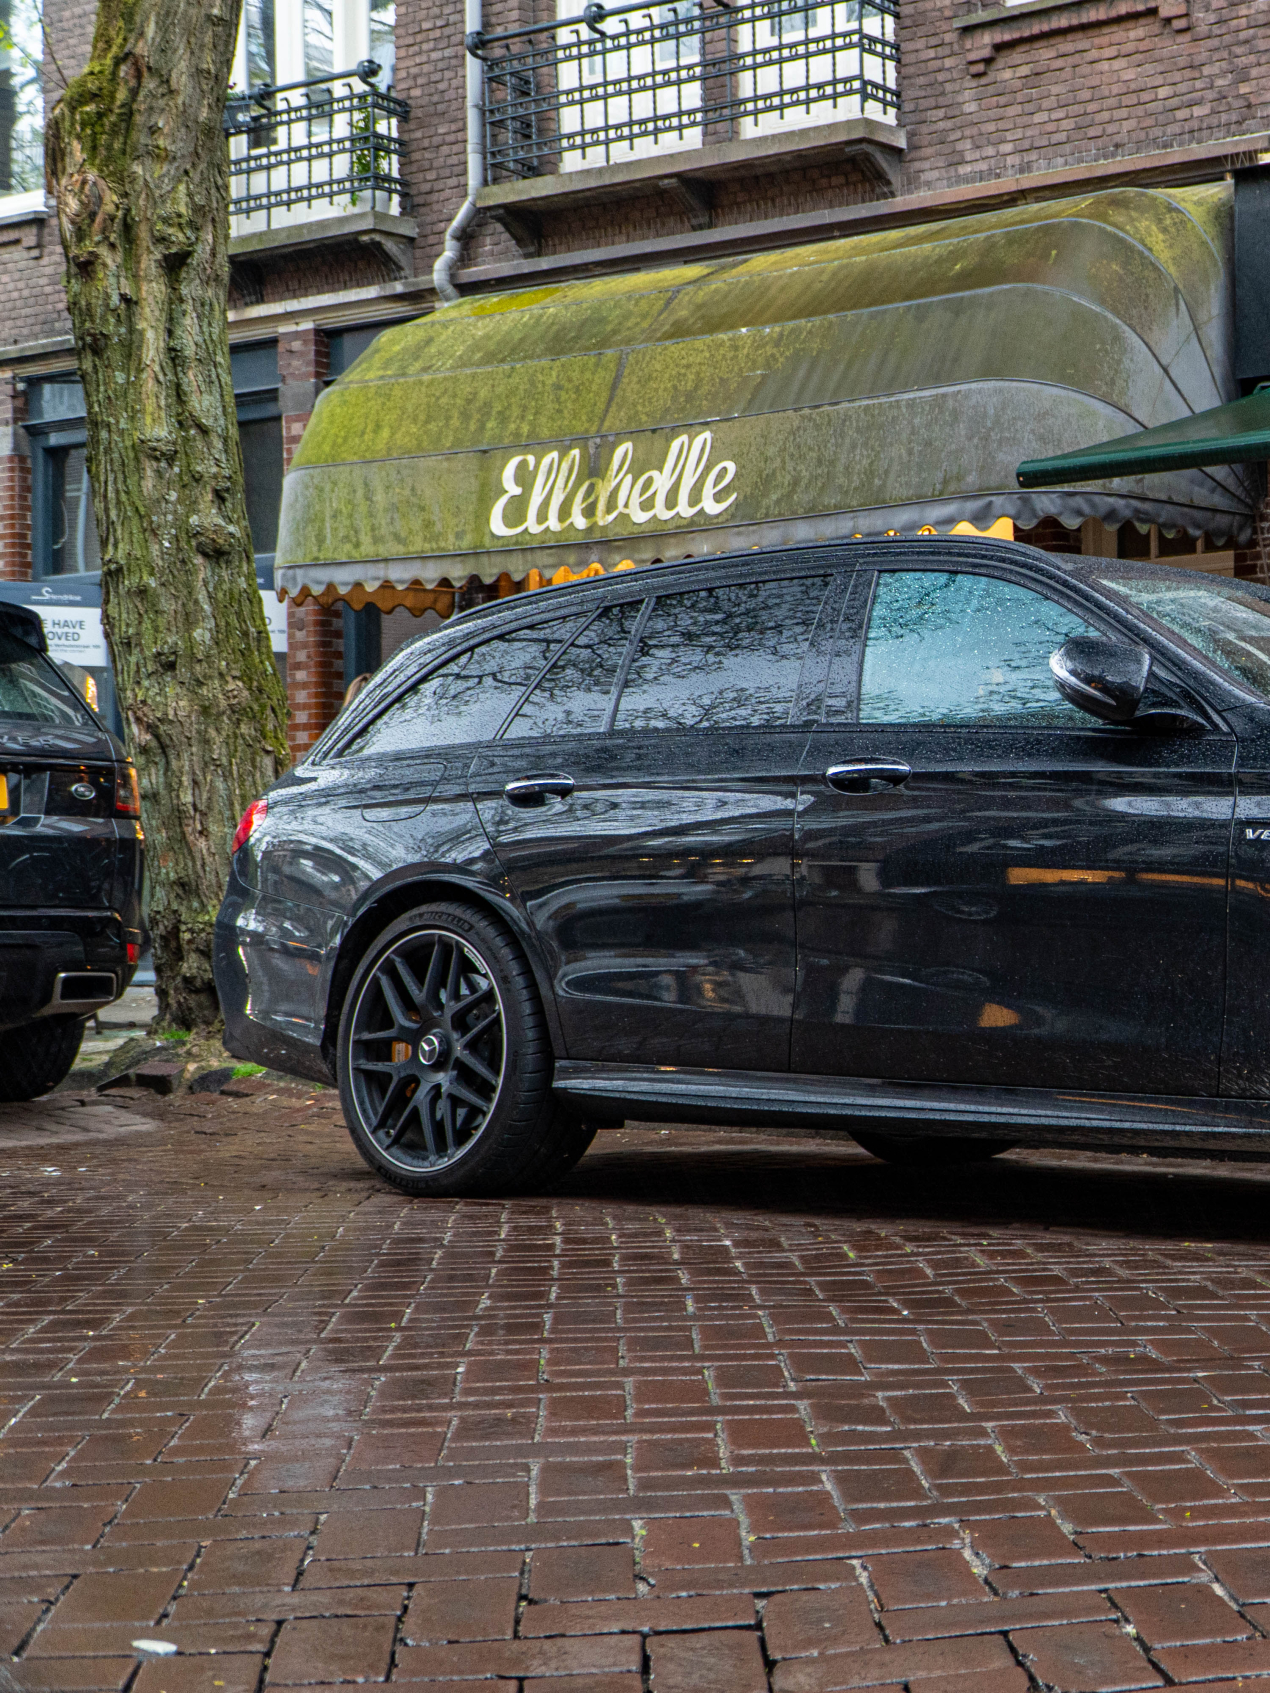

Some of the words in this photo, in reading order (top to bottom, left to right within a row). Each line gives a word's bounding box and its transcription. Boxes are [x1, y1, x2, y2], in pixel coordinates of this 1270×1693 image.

[489, 430, 738, 537] Ellebelle
[52, 619, 86, 630] HAVE
[46, 631, 81, 642] OVED
[423, 912, 472, 932] MICHELIN
